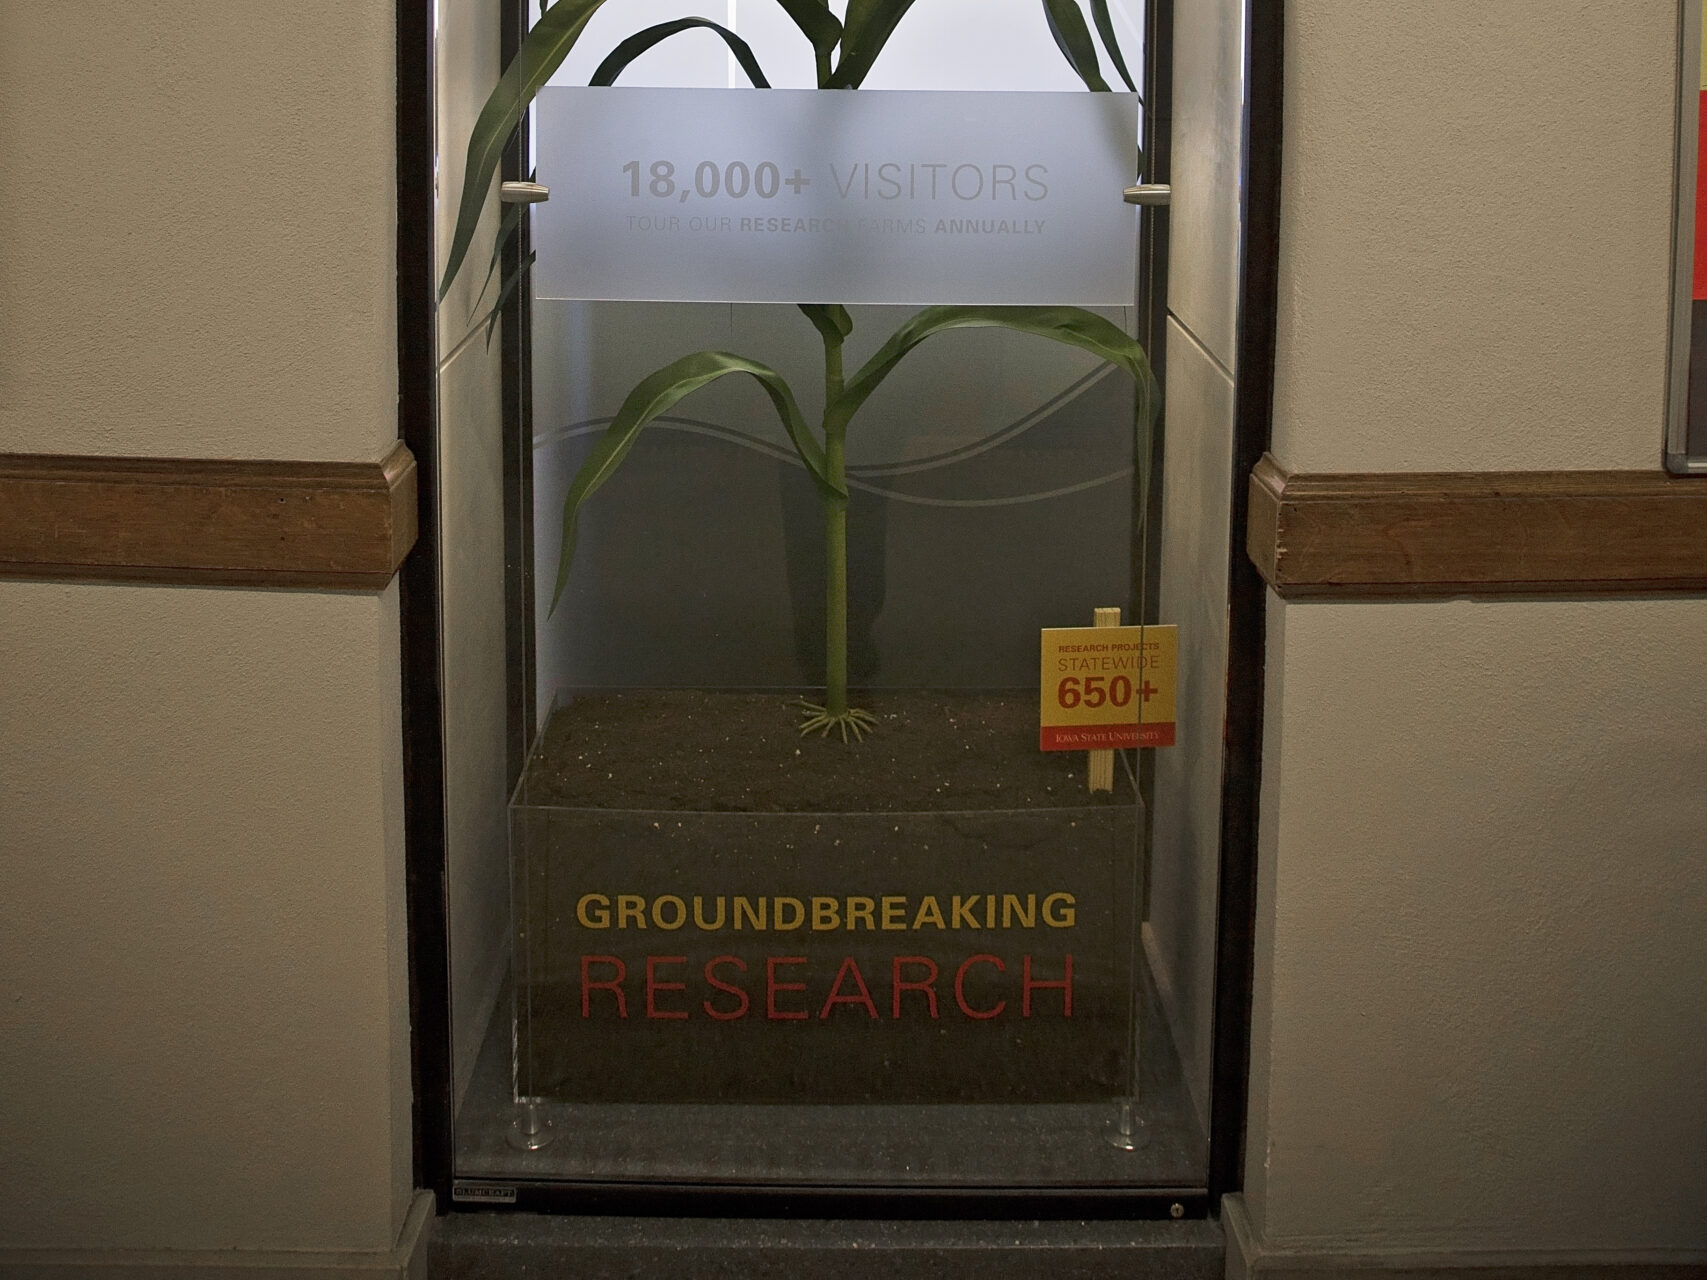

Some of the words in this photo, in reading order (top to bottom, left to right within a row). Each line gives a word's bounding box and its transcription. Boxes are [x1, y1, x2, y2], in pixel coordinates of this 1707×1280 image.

[622, 159, 811, 203] 18,000+
[828, 162, 1050, 201] VISITORS
[626, 215, 680, 232] TOUR
[689, 216, 731, 232] OUR
[740, 217, 844, 234] RESEARC
[934, 218, 1046, 234] ANNUALLY
[1058, 643, 1109, 653] RESEARCH
[1111, 642, 1160, 652] PROJECTS
[1058, 655, 1160, 672] STATEWIDE
[1057, 674, 1159, 709] 650+
[1055, 733, 1079, 743] IOWA
[1081, 732, 1106, 742] STATE
[575, 892, 1078, 931] GROUNDBREAKING
[580, 953, 1075, 1020] RESEARCH
